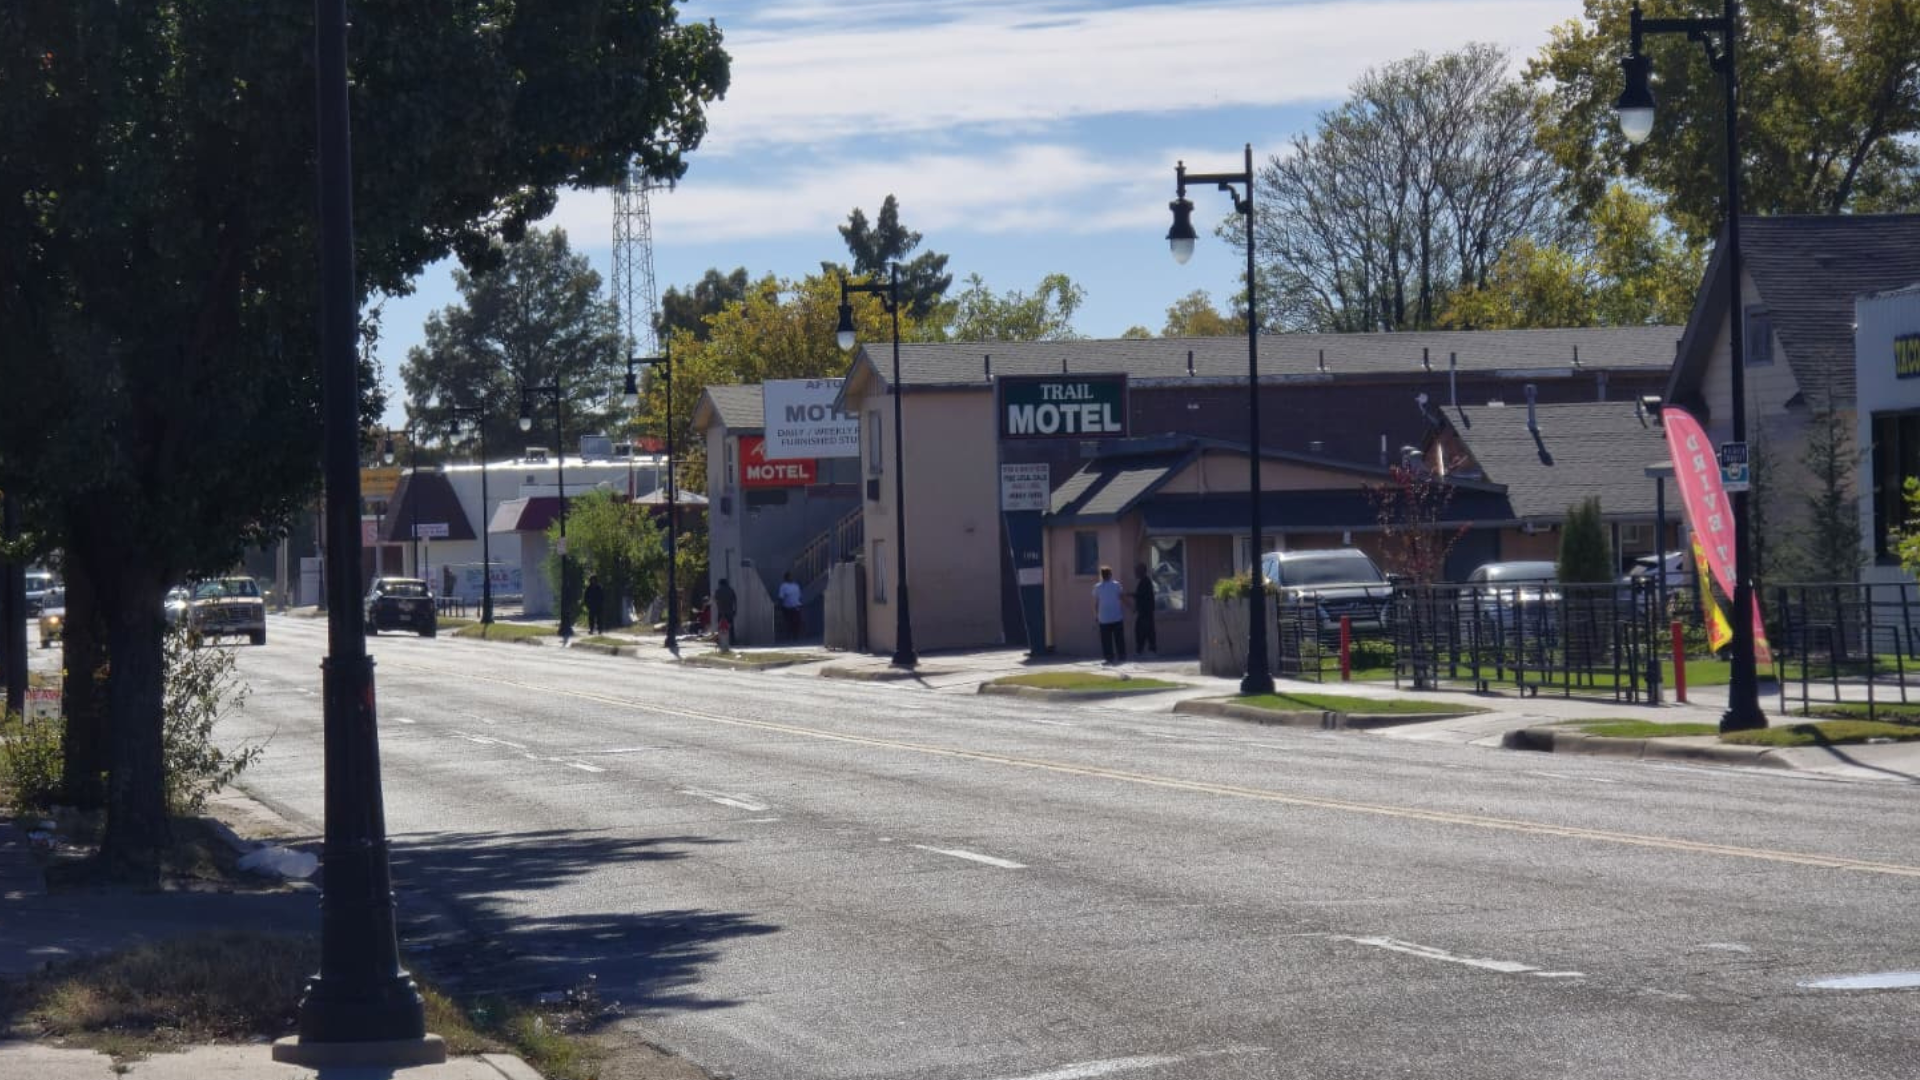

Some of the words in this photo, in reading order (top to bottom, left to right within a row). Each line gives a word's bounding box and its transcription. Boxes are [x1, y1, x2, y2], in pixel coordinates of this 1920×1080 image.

[1040, 383, 1094, 400] TRAIL
[1008, 403, 1122, 434] MOTEL
[815, 427, 853, 436] WEEKLY
[781, 437, 836, 446] FURNISHED
[747, 464, 809, 480] MOTEL
